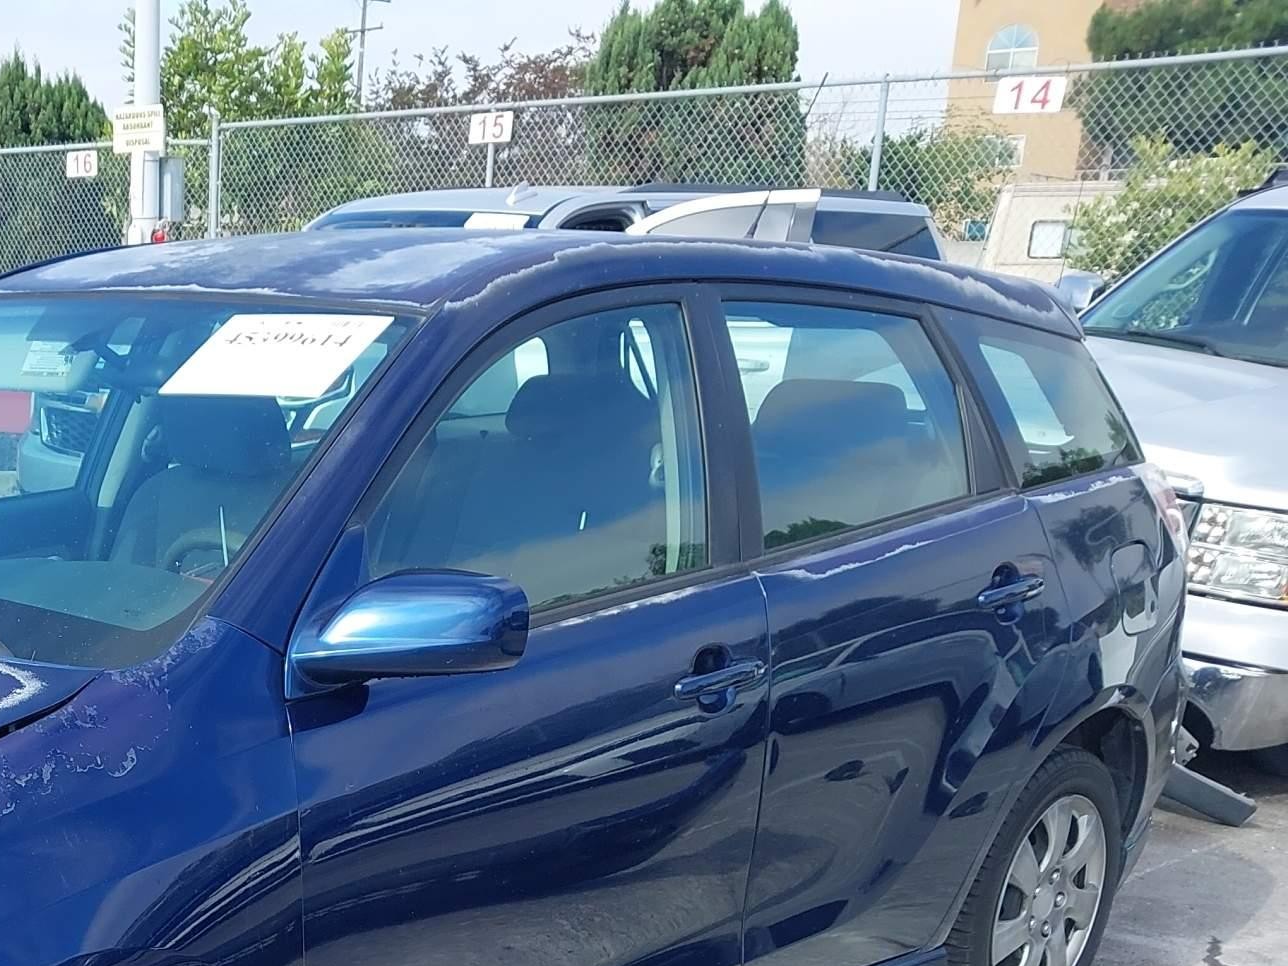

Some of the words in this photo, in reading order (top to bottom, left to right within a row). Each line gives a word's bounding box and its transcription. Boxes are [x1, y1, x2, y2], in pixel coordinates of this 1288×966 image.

[1010, 79, 1052, 110] 14
[478, 114, 504, 141] 15
[125, 138, 151, 146] DISPOSAL
[73, 153, 92, 174] 16
